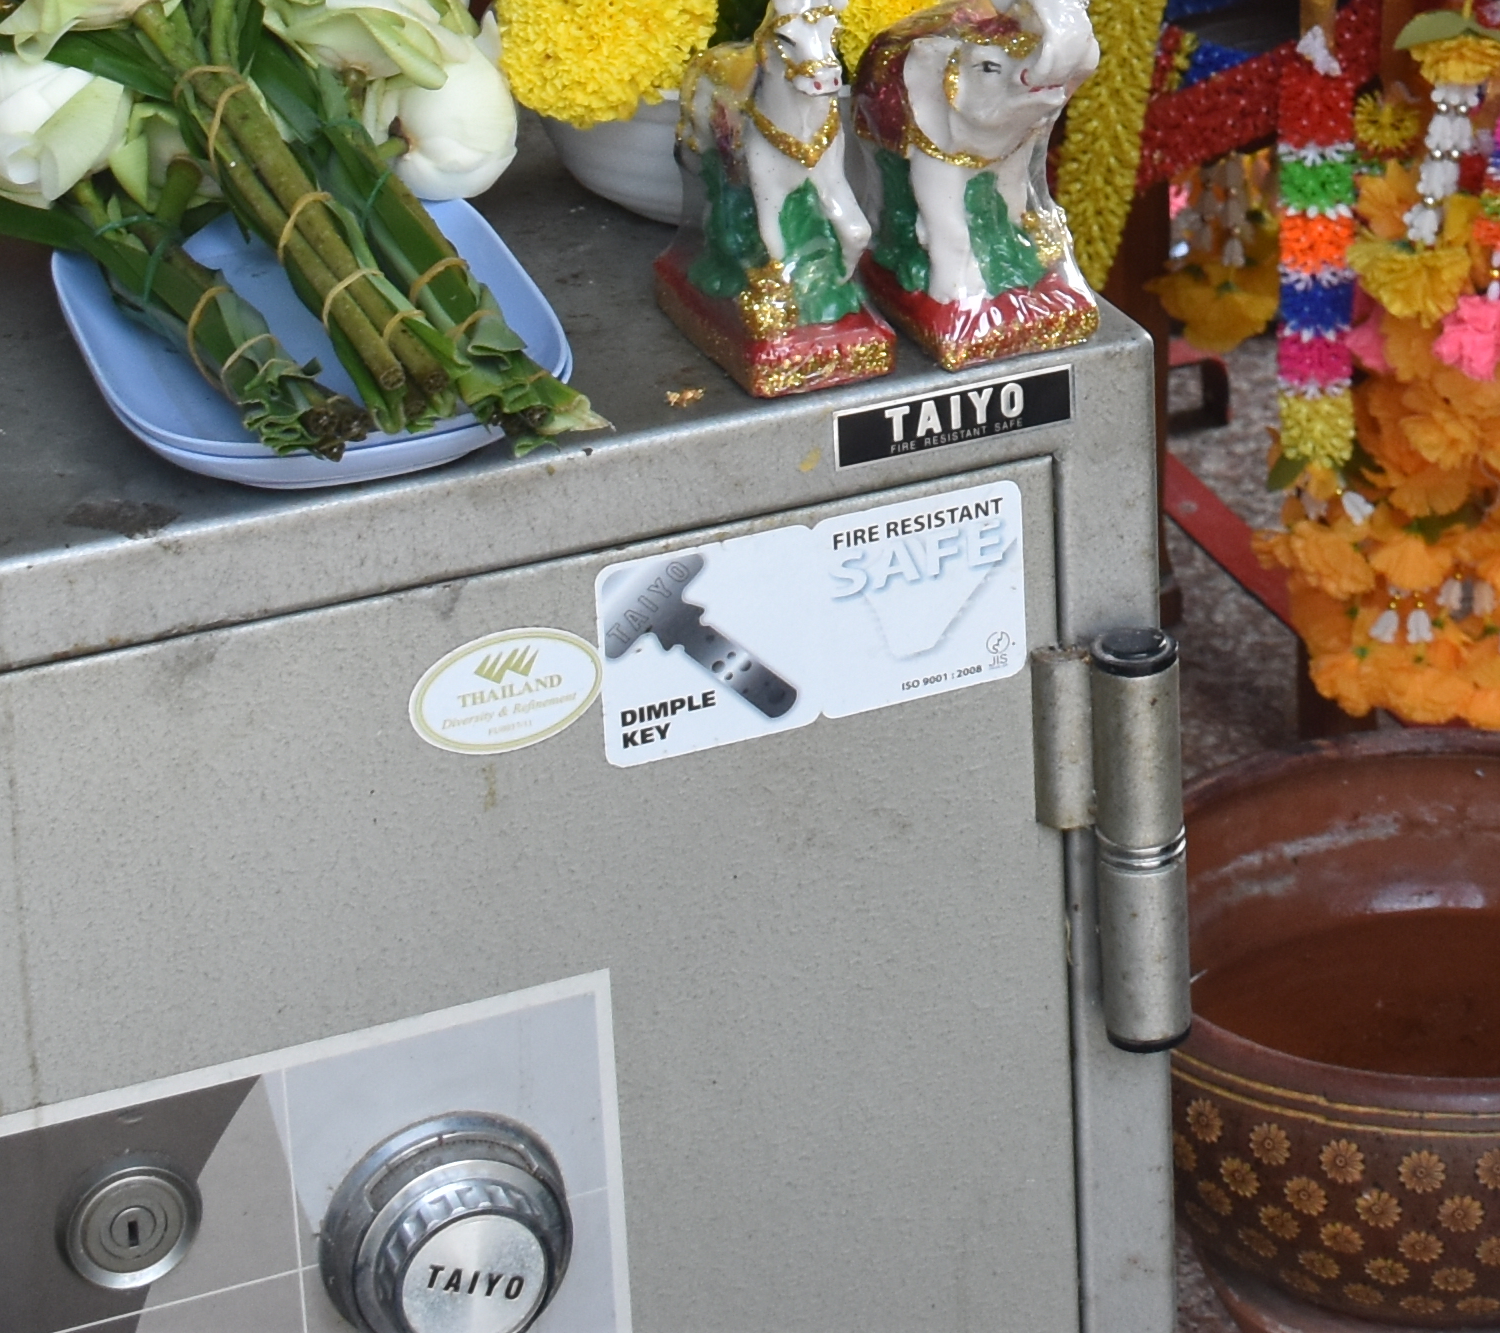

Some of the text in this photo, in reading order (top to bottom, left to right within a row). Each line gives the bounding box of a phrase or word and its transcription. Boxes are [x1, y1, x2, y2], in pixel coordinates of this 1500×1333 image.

[884, 382, 1024, 443] TAIYO
[890, 417, 1023, 454] FIRE RESISTANT SAFE
[833, 497, 1003, 550] FIRE RESISTANT
[831, 519, 1005, 599] SAFE
[607, 561, 689, 645] TAIYO
[902, 679, 920, 691] ISO
[923, 674, 948, 686] 9001
[957, 665, 982, 679] 2008
[988, 653, 1008, 666] JIS
[457, 673, 563, 708] THAILAND
[620, 690, 717, 727] DIMPLE
[441, 710, 495, 730] Diversity
[513, 691, 578, 715] Refinement
[622, 722, 672, 749] KEY
[427, 1264, 525, 1300] TAIYO
